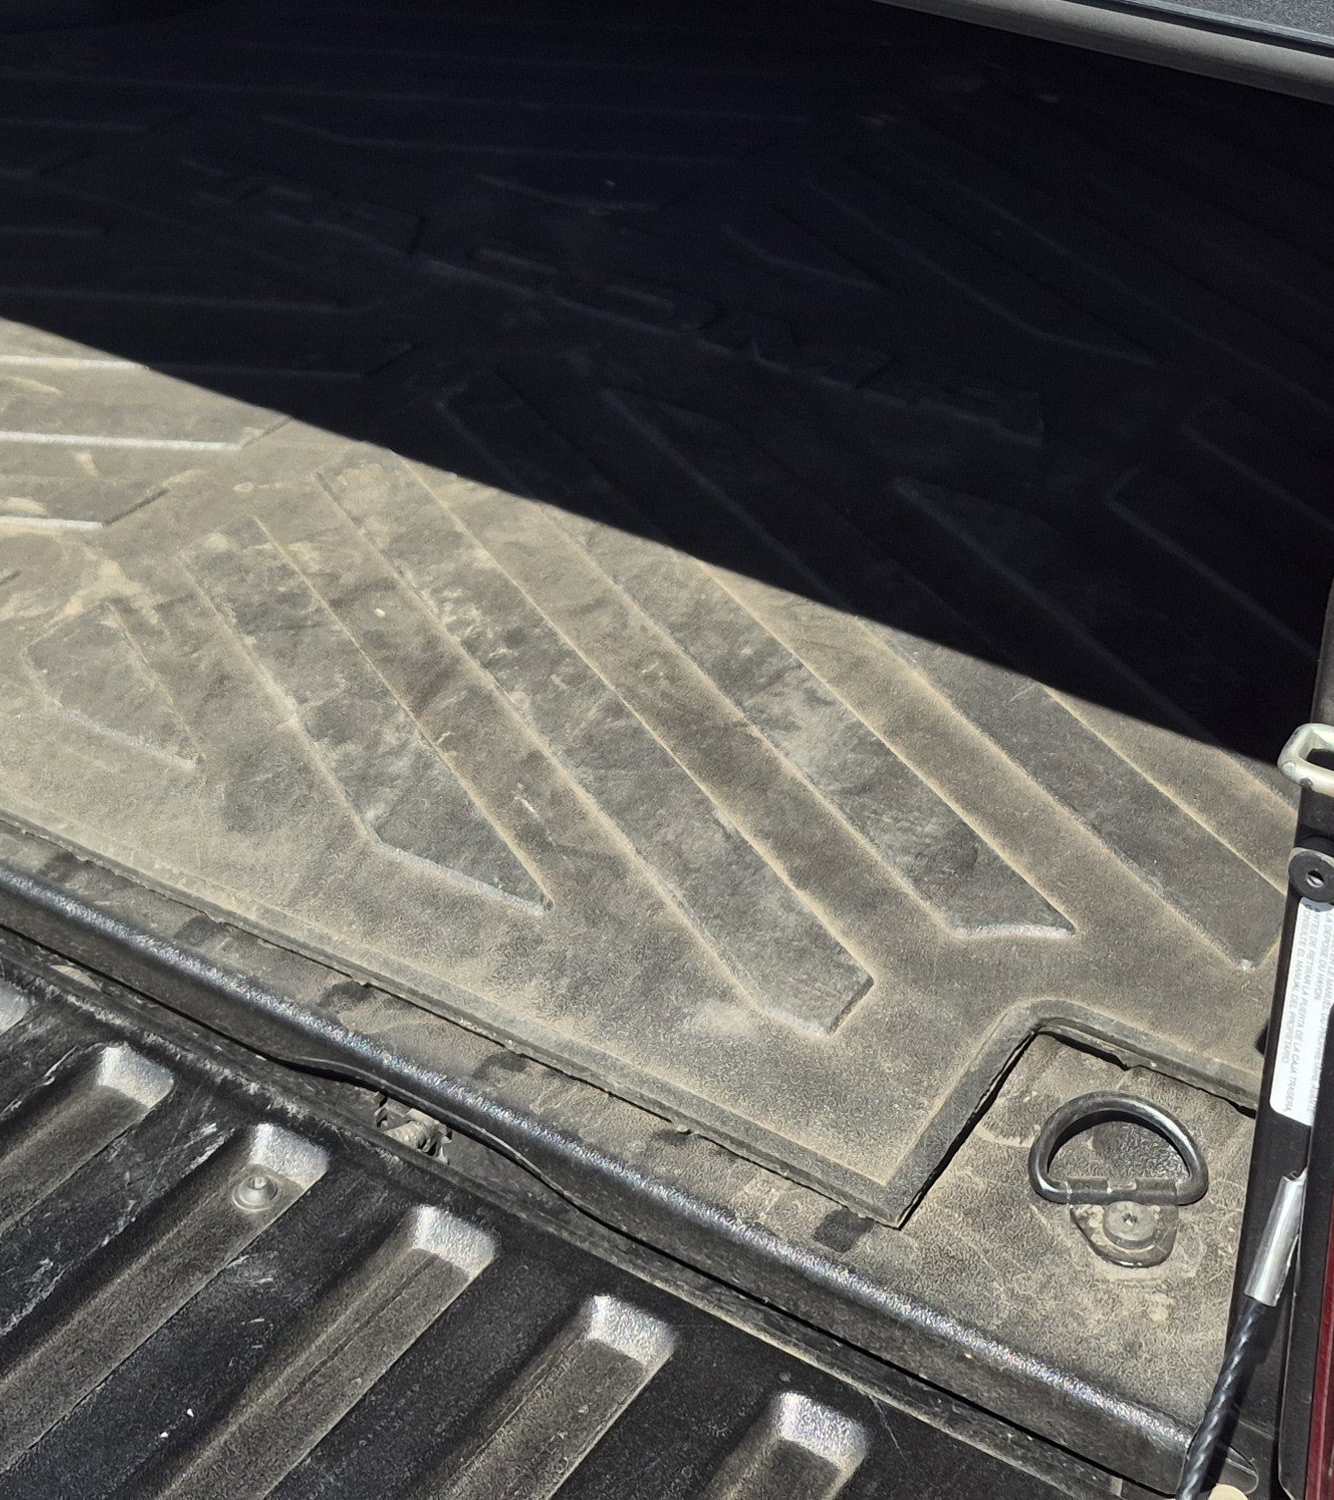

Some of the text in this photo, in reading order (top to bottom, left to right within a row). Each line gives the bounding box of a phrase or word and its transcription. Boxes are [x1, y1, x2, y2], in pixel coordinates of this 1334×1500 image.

[1326, 913, 1333, 923] LA
[1297, 948, 1305, 957] EL
[1292, 960, 1303, 991] MANUAL
[1327, 966, 1334, 977] LE
[1302, 985, 1309, 995] LA
[1322, 978, 1333, 1011] MANUEL
[1289, 994, 1298, 1008] DEL
[1293, 1042, 1300, 1052] LA
